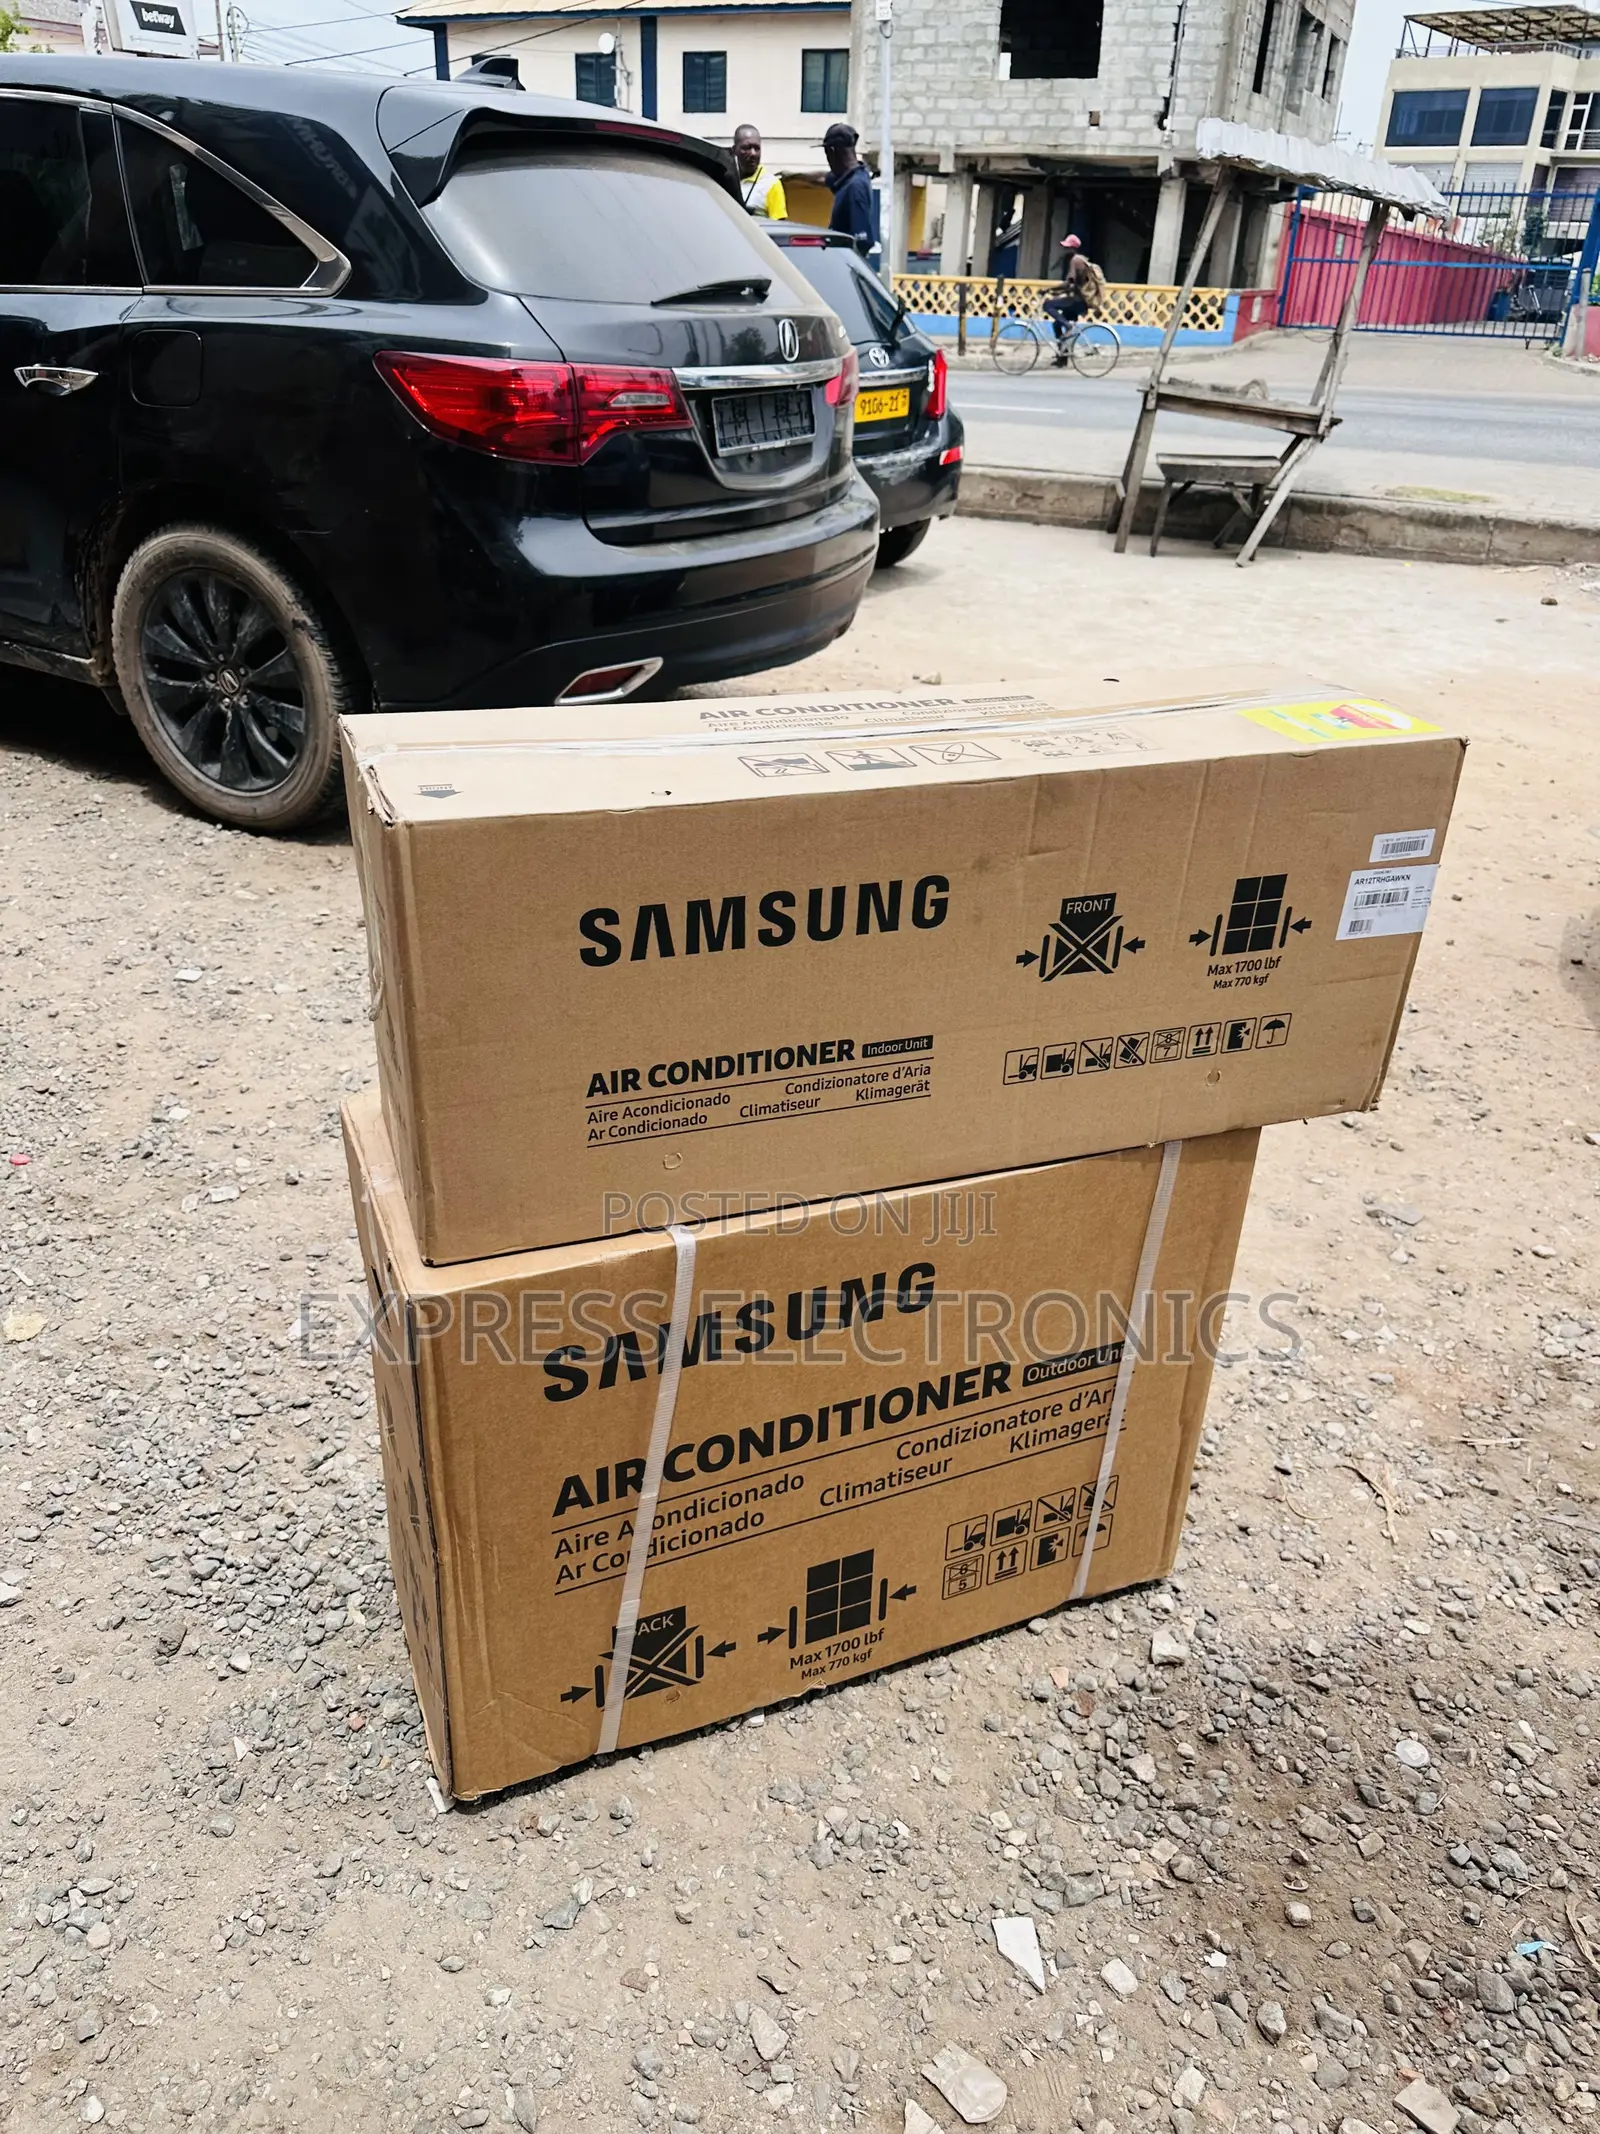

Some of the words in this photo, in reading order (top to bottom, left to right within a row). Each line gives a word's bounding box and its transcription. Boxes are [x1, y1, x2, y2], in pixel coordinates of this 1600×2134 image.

[141, 7, 175, 28] betway
[700, 709, 750, 720] AIR
[755, 698, 955, 716] CONDITIONER
[742, 714, 850, 725] Acondicionado
[729, 720, 833, 732] Condicionado
[579, 874, 950, 967] SAMSUNG
[1065, 897, 1112, 915] FRONT
[1207, 964, 1233, 977] Max
[1235, 958, 1262, 973] 1700
[1264, 955, 1283, 970] lbf
[1213, 979, 1233, 990] Max
[1234, 976, 1251, 987] 770
[1252, 972, 1270, 987] kgf
[586, 1067, 641, 1098] AIR
[647, 1038, 856, 1088] CONDITIONER
[867, 1042, 903, 1056] Indoor
[905, 1037, 928, 1050] Unit
[785, 1071, 889, 1096] Condizionatore
[892, 1063, 931, 1080] d'Aria
[855, 1079, 931, 1102] Klimagerät
[587, 1107, 619, 1126] Aire
[622, 1092, 731, 1121] Acondicionado
[739, 1095, 821, 1119] Climatiseur
[587, 1127, 606, 1142] Ar
[608, 1112, 708, 1139] Condicionado
[543, 1262, 936, 1402] SAMSUNG
[552, 1457, 648, 1518] AIR
[662, 1361, 1012, 1484] CONDITIONER
[1026, 1354, 1096, 1382] Outdoor
[1096, 1342, 1126, 1364] Uni
[896, 1402, 1063, 1461] Condizionatore
[1068, 1383, 1117, 1412] d'Ari
[819, 1457, 953, 1507] Climatiseur
[554, 1529, 610, 1560] Aire
[617, 1473, 805, 1542] Aondicionado
[555, 1562, 586, 1585] Ar
[636, 1613, 674, 1637] ACK
[790, 1650, 823, 1670] Max
[825, 1636, 861, 1659] 1700
[864, 1627, 886, 1646] lbf
[800, 1664, 827, 1681] Max
[829, 1655, 850, 1671] 770
[852, 1647, 873, 1663] kgf
